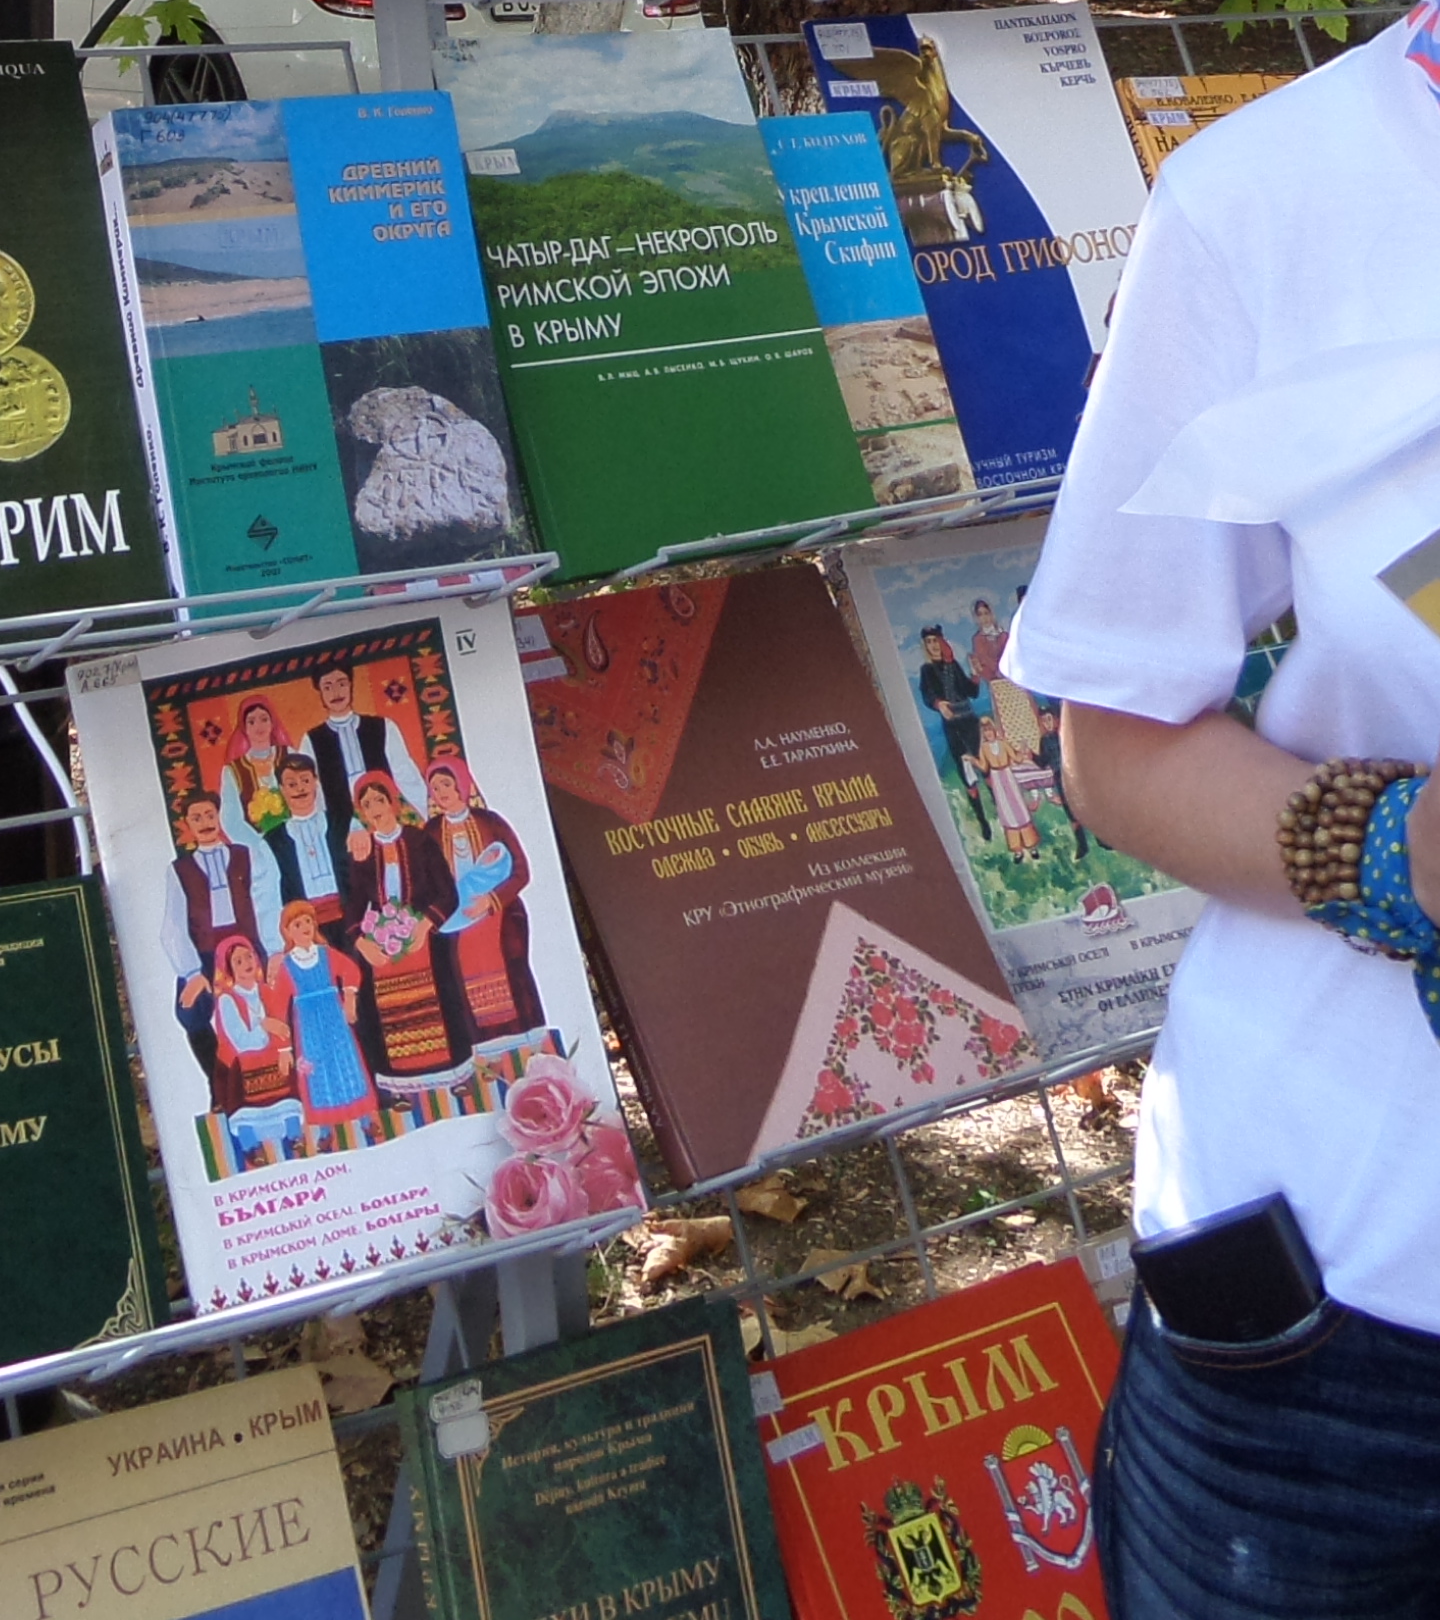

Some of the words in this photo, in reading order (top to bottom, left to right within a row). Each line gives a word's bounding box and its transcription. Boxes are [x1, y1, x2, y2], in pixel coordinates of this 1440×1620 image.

[1043, 43, 1086, 56] VOSPRO
[832, 82, 877, 96] КРЫМ
[342, 158, 441, 182] ДРЕВНИЙ
[328, 179, 445, 204] КИММЕРИК
[410, 199, 448, 218] ЕГО
[372, 220, 451, 243] ОКРУГА
[797, 207, 890, 237] Крымской
[486, 234, 611, 271] ЧАТЫР-ДАГ
[635, 221, 779, 260] НЕКРОПОЛЬ
[497, 272, 633, 309] РИМСКОЙ
[643, 263, 732, 297] ЭПОХИ
[508, 323, 524, 348] В
[535, 313, 623, 345] КРЫМУ
[1015, 448, 1057, 464] ТУРИЗМ
[779, 722, 852, 747] НАУМЕНКО,
[783, 738, 859, 764] ТАРАТУХИНА
[605, 807, 721, 856] ВОСТОЧНЫЕ
[726, 788, 809, 829] СЛАВЯНЕ
[814, 772, 879, 809] КРЫМА
[808, 862, 827, 877] Из
[682, 905, 714, 928] КРУ
[218, 1186, 327, 1227] БЪЛГАРИ
[808, 1334, 1059, 1472] КРЫМ
[106, 1428, 226, 1477] УКРАИНА
[248, 1399, 323, 1439] КРЫМ
[28, 1496, 313, 1620] РУССКИЕ
[623, 1555, 720, 1614] КРЫМУ
